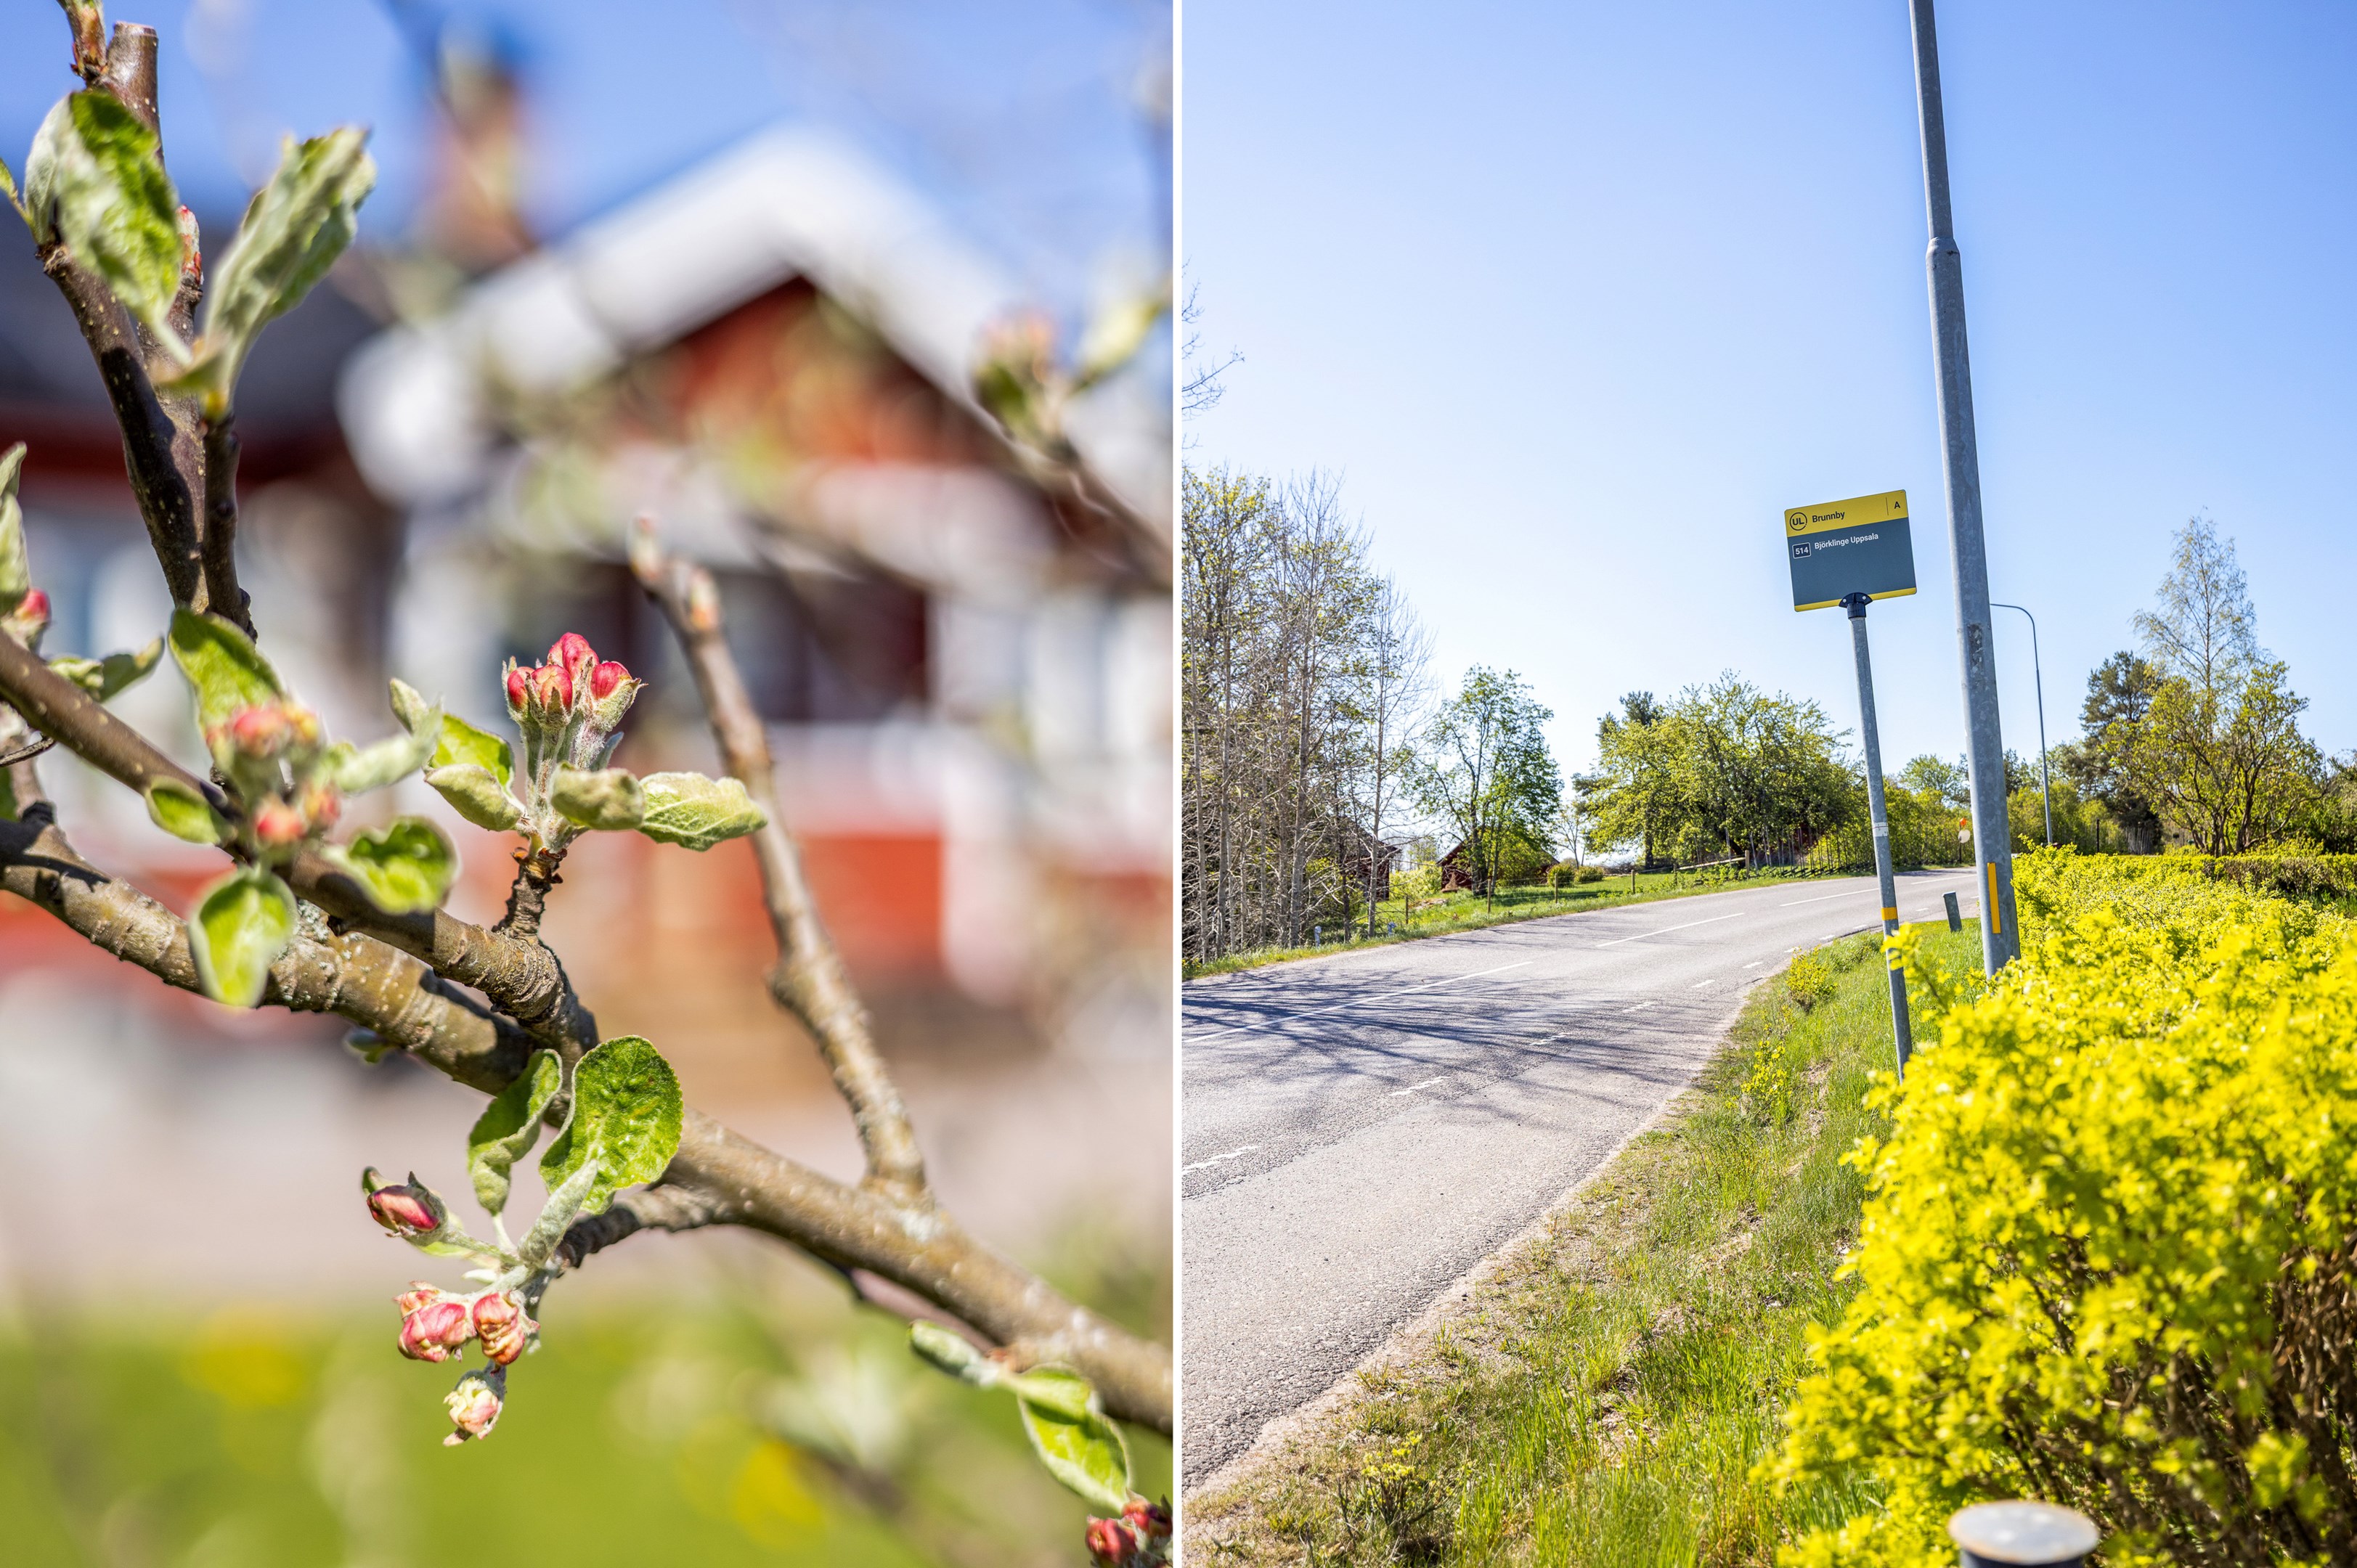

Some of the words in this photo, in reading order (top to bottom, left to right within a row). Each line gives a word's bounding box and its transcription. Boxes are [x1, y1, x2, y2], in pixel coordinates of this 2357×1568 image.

[1792, 517, 1804, 526] UL
[1812, 511, 1845, 523] Brunnby
[1815, 538, 1849, 550] Björklinge
[1850, 533, 1878, 544] Uppsala
[1795, 547, 1809, 555] 514
